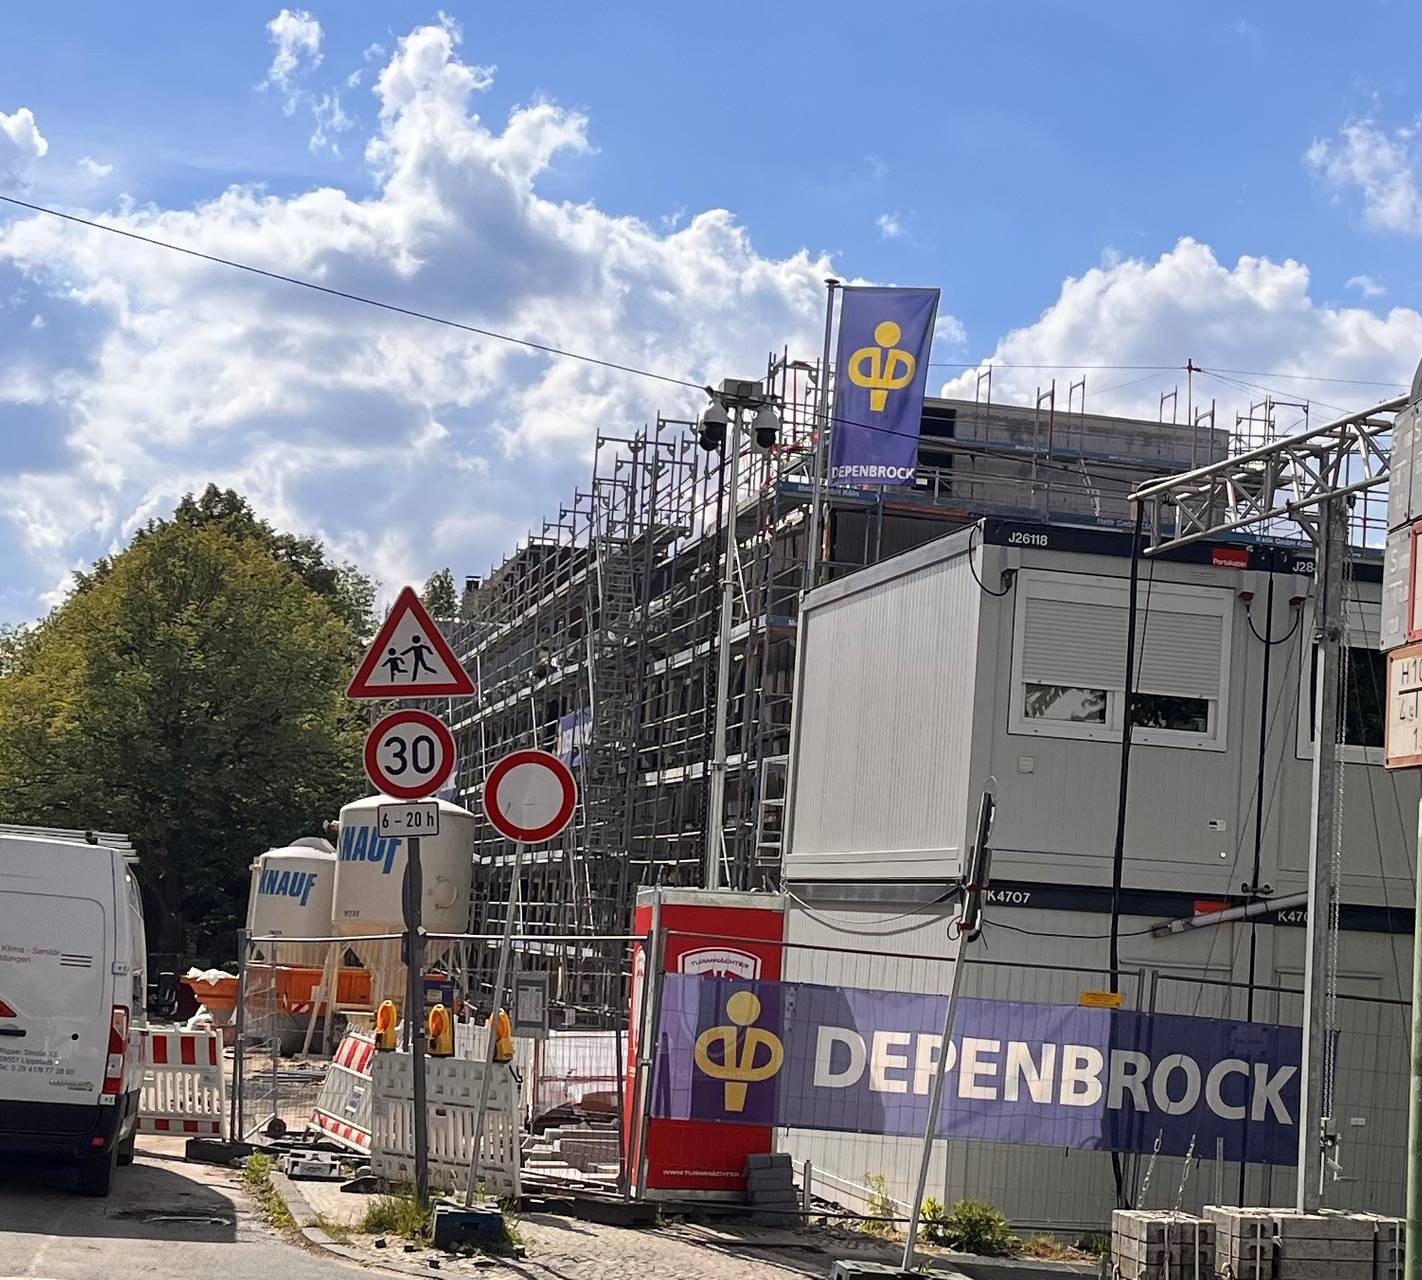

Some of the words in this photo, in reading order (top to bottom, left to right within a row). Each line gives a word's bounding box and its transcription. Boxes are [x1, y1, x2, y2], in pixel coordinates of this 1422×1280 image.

[831, 465, 916, 480] DEPENBROCK
[1008, 532, 1049, 546] J26118
[384, 735, 436, 776] 30
[382, 813, 390, 828] 6
[406, 811, 422, 827] 20
[427, 811, 434, 827] h
[258, 869, 318, 907] KNAUF
[987, 890, 1032, 904] K4707
[812, 1024, 1299, 1126] DEPENBROCK
